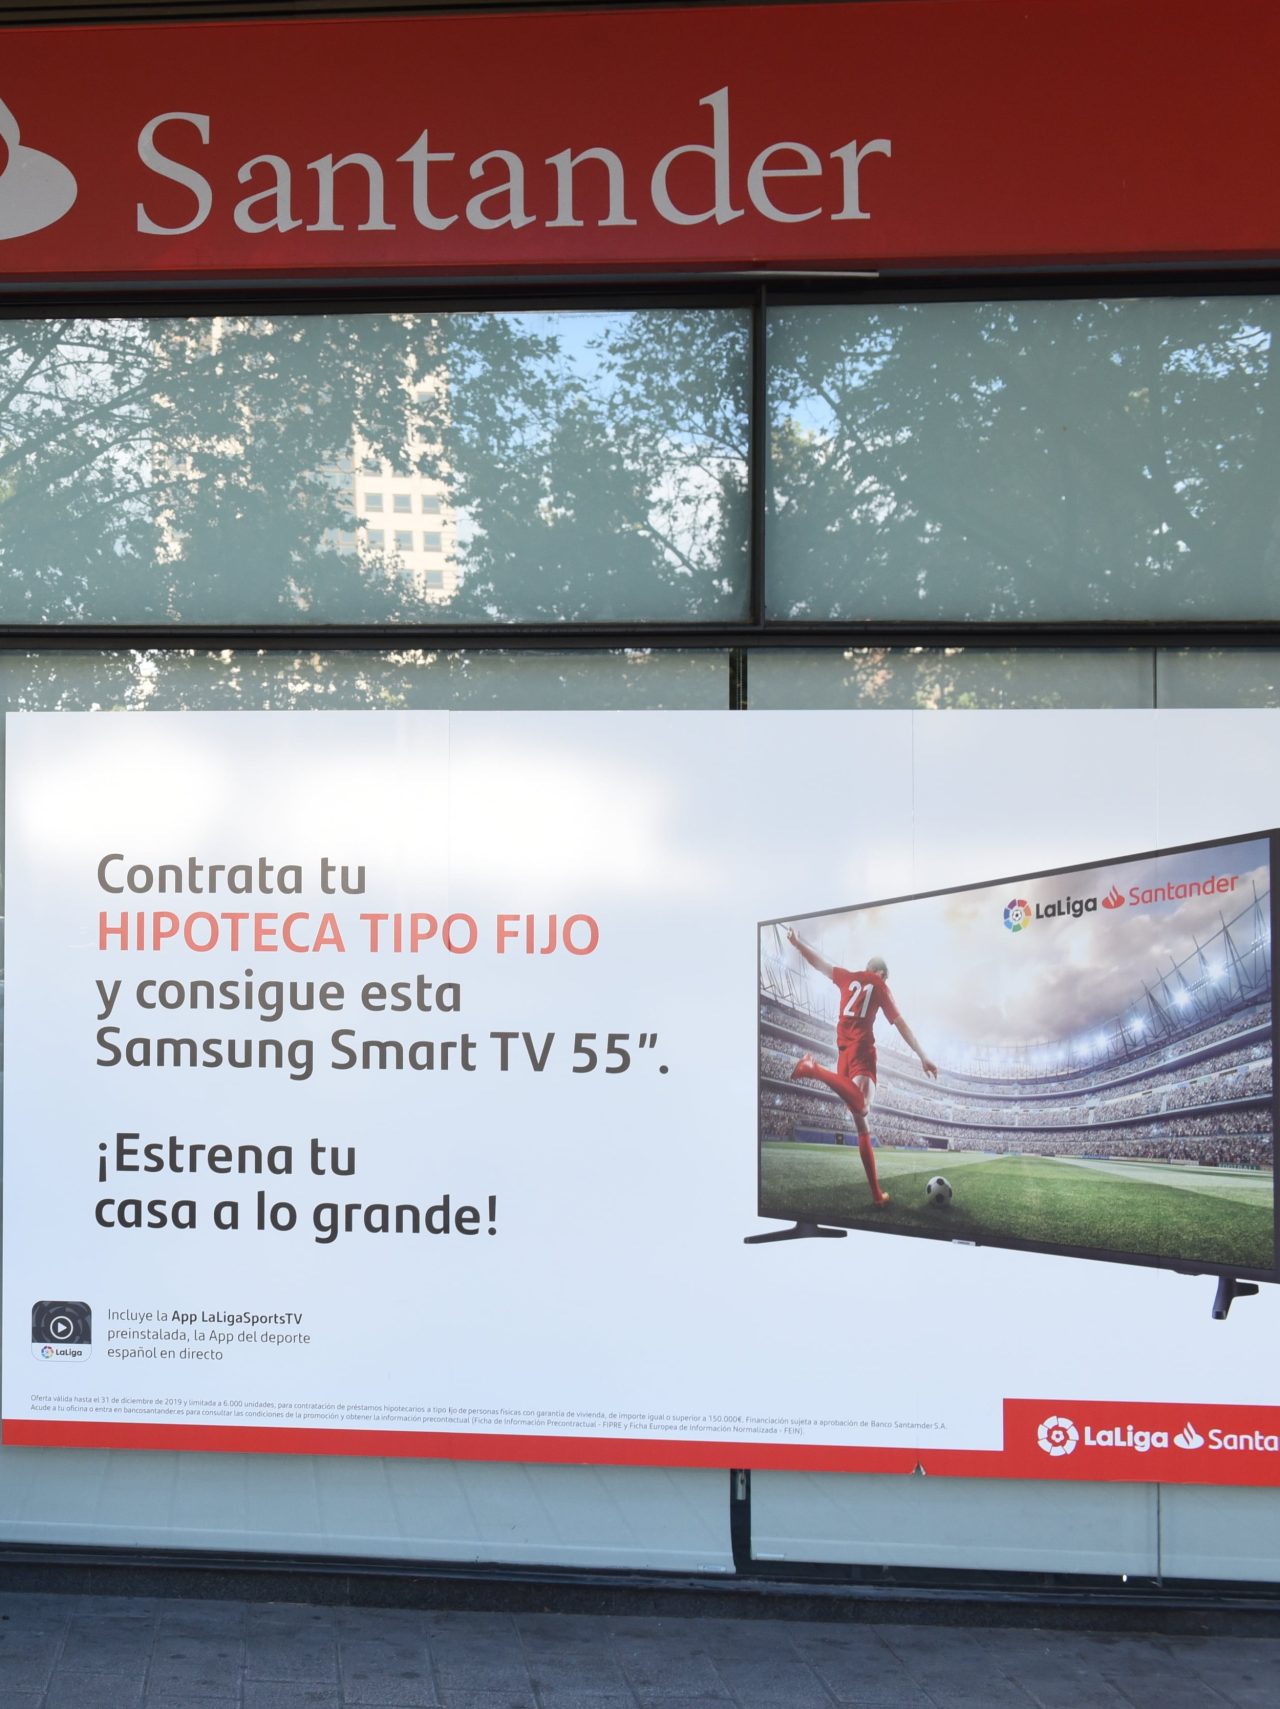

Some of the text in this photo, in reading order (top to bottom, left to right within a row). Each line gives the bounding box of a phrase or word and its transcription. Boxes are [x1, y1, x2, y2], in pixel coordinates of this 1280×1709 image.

[136, 85, 892, 236] Santander
[98, 854, 365, 894] Contrata tu
[1035, 875, 1239, 919] LaLiga Santander
[99, 911, 599, 955] HIPOTECA TIPO FIJO
[96, 969, 460, 1022] y consigue esta
[843, 980, 874, 1018] 21
[97, 1026, 313, 1081] Samsung
[331, 1029, 476, 1071] Smart
[490, 1032, 555, 1072] TV
[99, 1133, 355, 1182] ¡Estrena tu
[95, 1191, 496, 1244] casa a lo grande!
[108, 1309, 302, 1326] Incluye la App LaLigaSportsTV
[108, 1327, 310, 1345] preinstalada, la App del deporte
[55, 1348, 83, 1358] LaLiga
[108, 1347, 222, 1360] español en directo
[1084, 1424, 1280, 1453] LaLiga Santa
